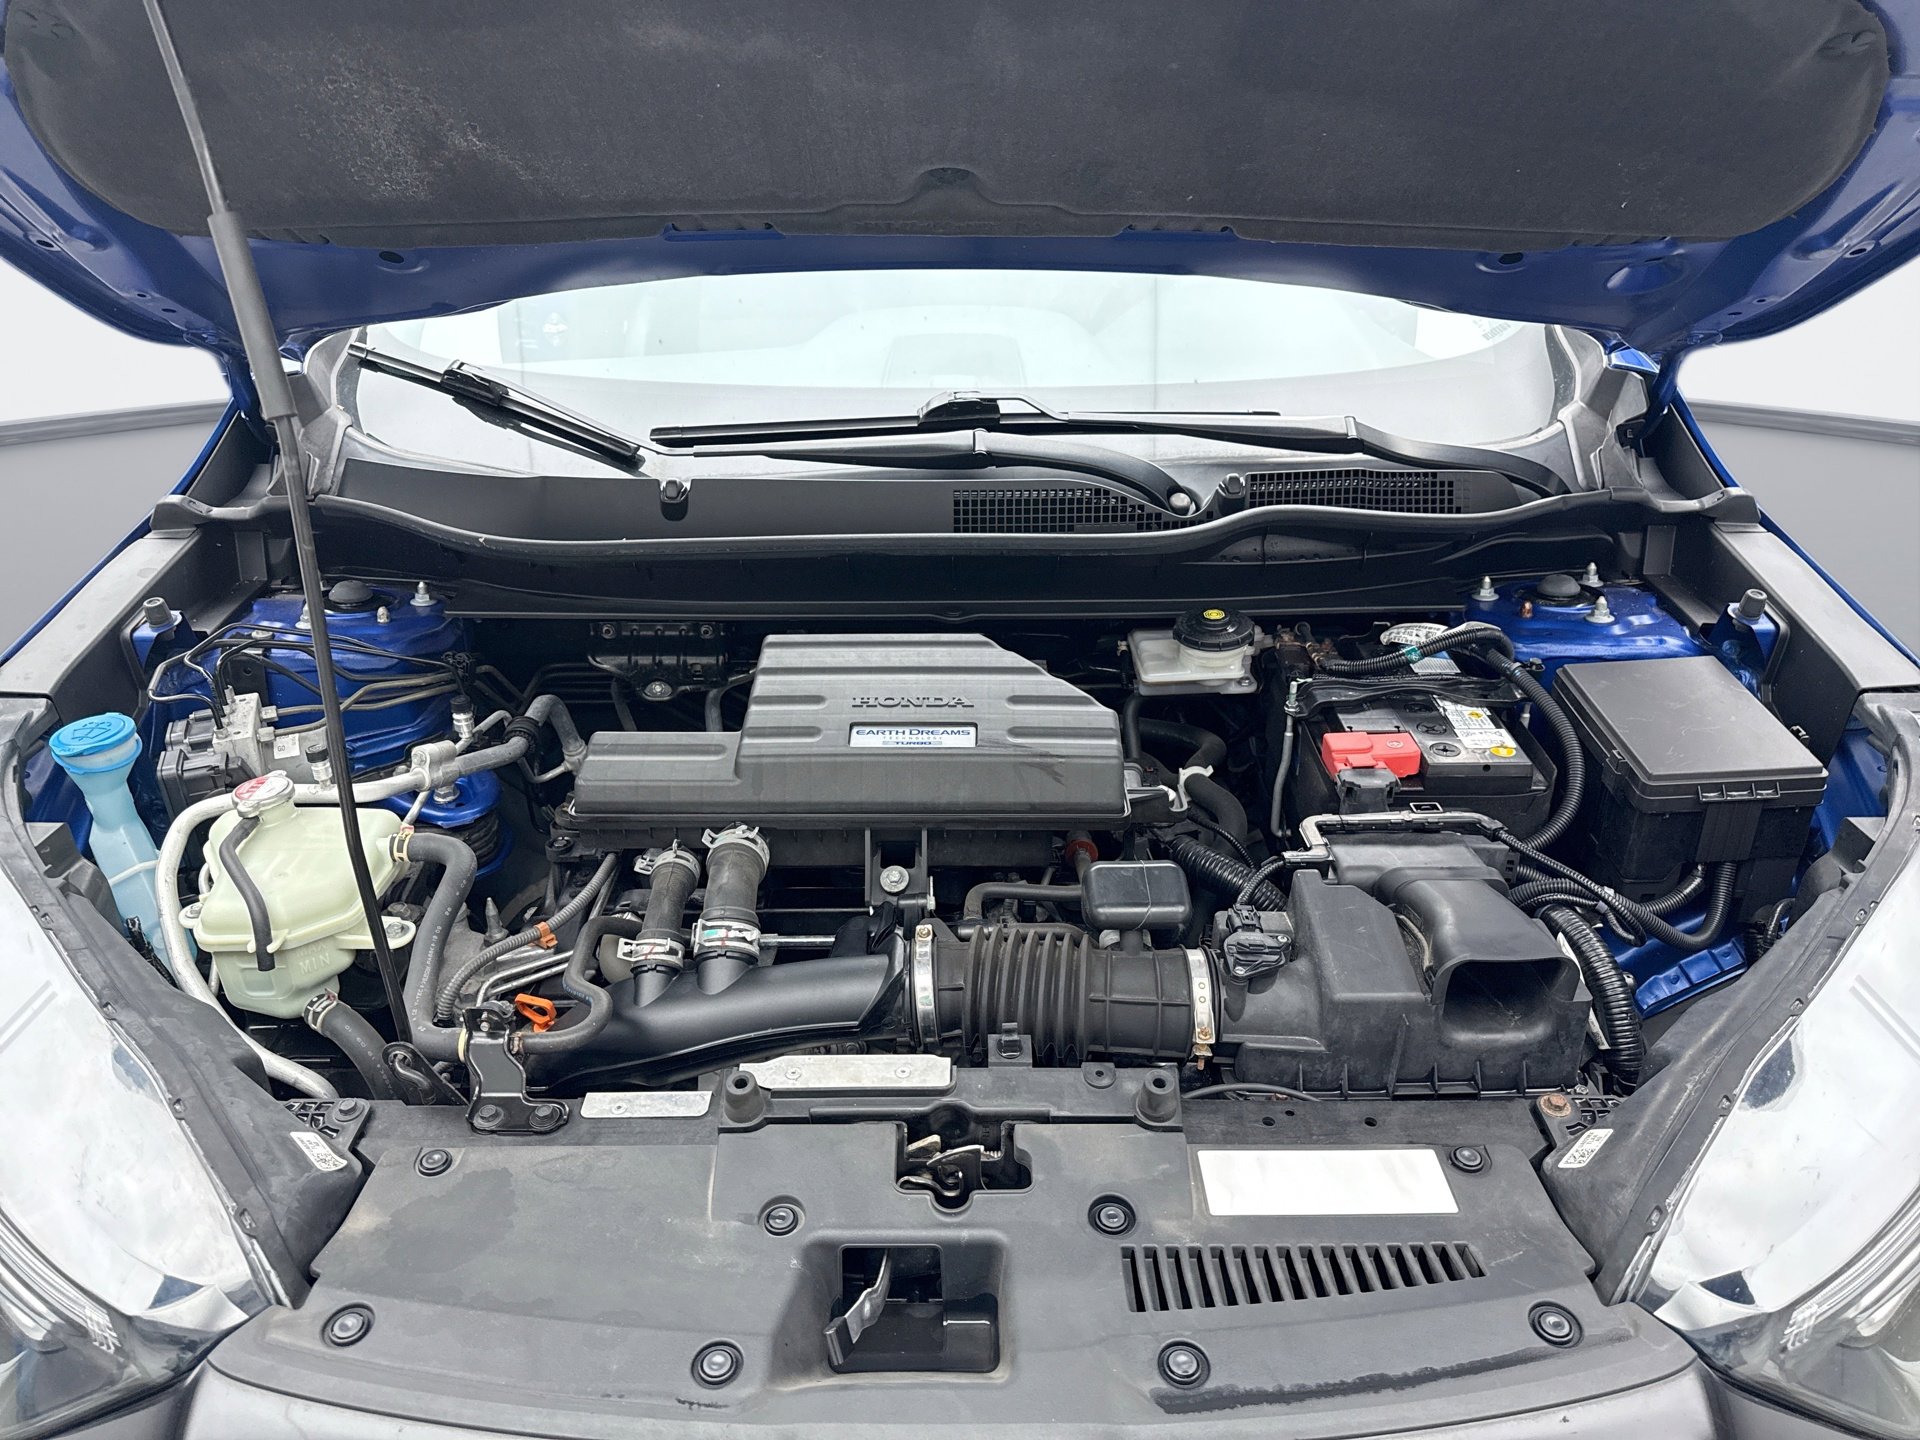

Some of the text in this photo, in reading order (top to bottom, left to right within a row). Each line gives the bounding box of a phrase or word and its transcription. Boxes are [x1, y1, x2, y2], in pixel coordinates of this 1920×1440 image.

[852, 695, 974, 708] HONDA
[909, 728, 971, 736] DREAMS
[299, 952, 330, 975] MIN
